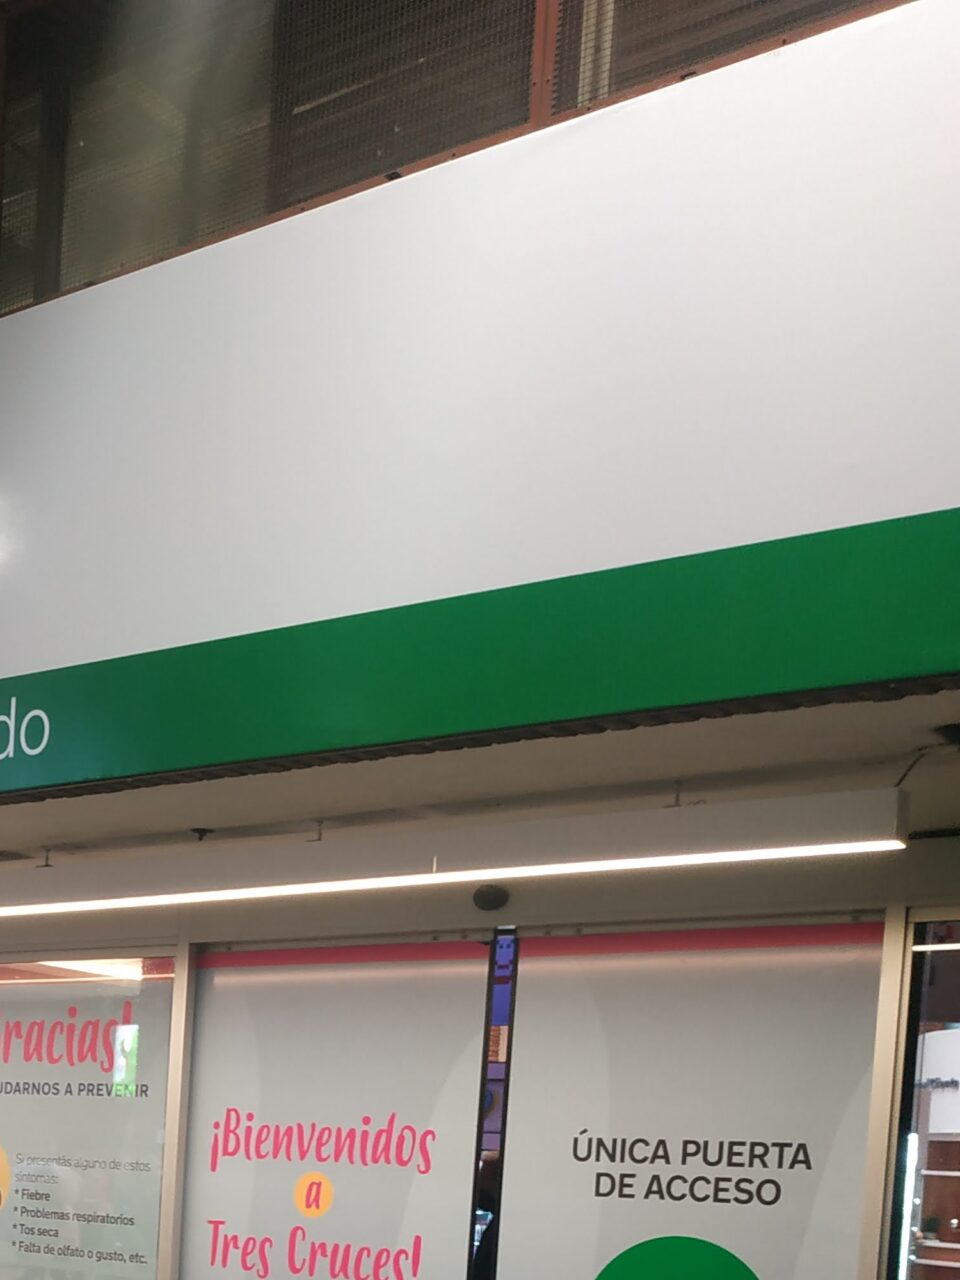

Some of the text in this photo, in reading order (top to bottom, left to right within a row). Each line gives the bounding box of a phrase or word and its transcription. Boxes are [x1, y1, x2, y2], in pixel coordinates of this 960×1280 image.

[63, 1083, 73, 1096] A
[77, 1083, 149, 1098] PREVENIR
[209, 1107, 437, 1175] ¡Bienvenidos
[572, 1128, 813, 1171] ÚNICA PUERTA
[21, 1188, 51, 1202] Fiebre
[304, 1179, 322, 1210] a
[593, 1172, 782, 1206] DE ACCESO
[20, 1206, 135, 1226] Problemas respiratorios
[19, 1223, 59, 1238] Tos seca
[18, 1241, 148, 1265] Falta de olfato o gusto, etc.
[207, 1219, 273, 1280] Tres
